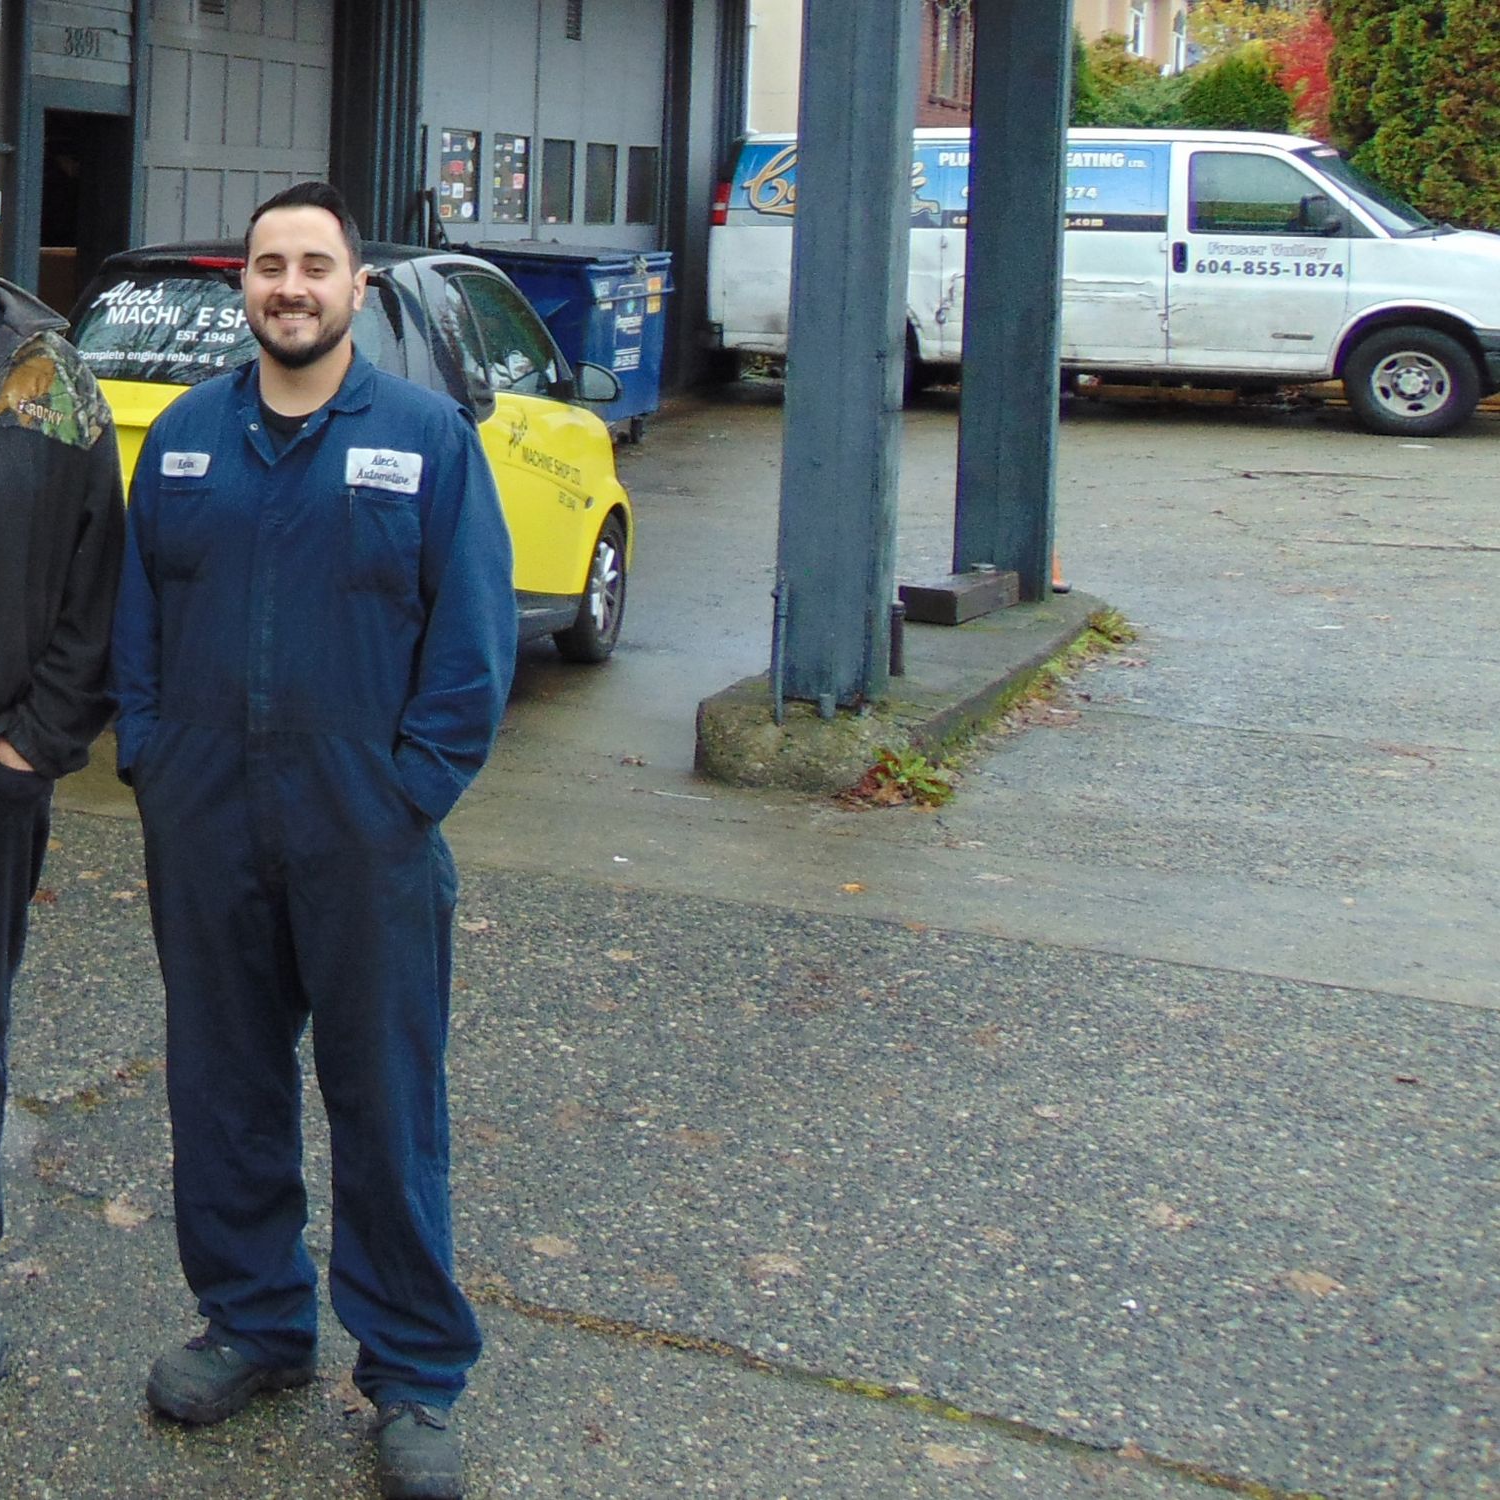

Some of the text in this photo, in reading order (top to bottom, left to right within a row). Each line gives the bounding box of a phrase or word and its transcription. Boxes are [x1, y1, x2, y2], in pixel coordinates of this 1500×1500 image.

[63, 26, 101, 57] 3891
[1066, 152, 1125, 168] EATING
[1208, 242, 1328, 259] Fraser Valley
[1195, 259, 1344, 278] 604-855-1874
[106, 305, 215, 327] MACHIE
[175, 330, 235, 344] EST. 1948
[78, 350, 125, 363] Complete
[127, 351, 164, 363] engine
[370, 454, 399, 468] Alec's
[356, 467, 411, 486] Automotive
